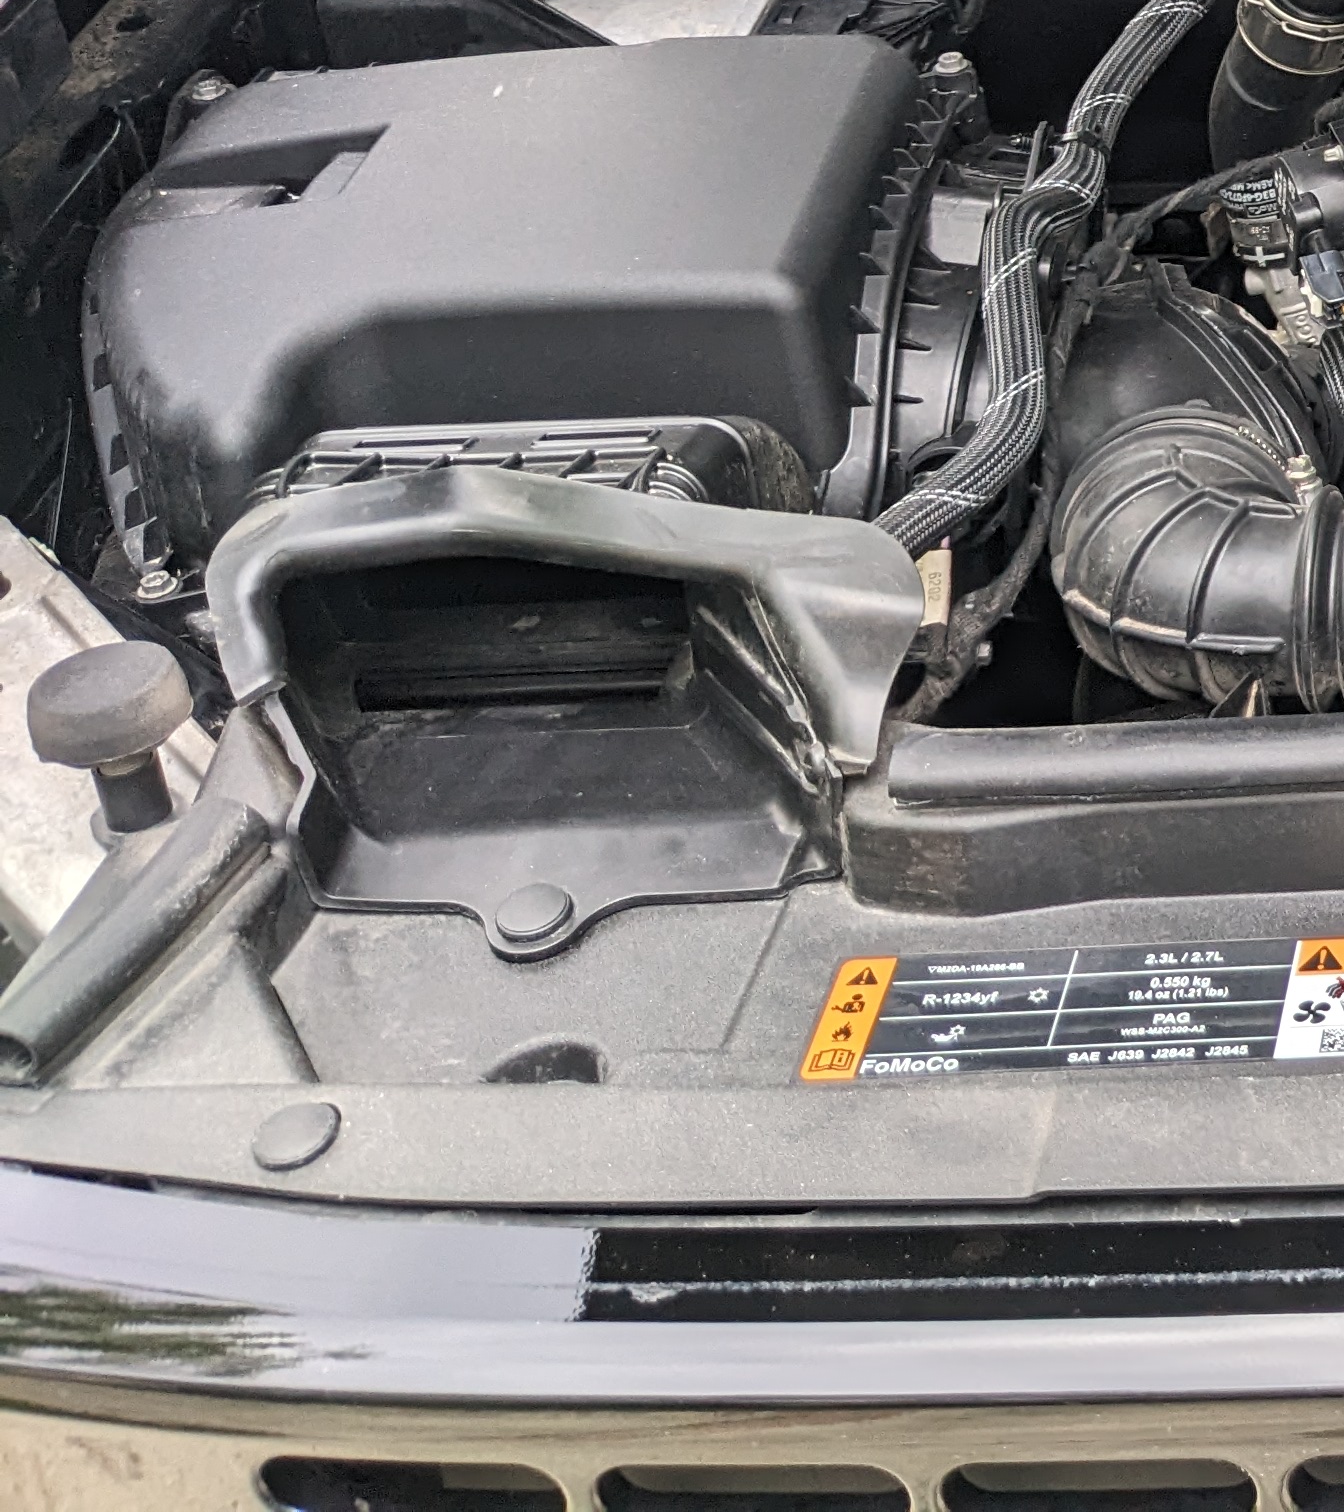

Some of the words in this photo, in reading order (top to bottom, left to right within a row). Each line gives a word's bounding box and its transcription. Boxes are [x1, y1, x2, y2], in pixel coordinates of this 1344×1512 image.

[927, 570, 942, 603] 6202
[1144, 952, 1178, 965] 2.3L
[1189, 950, 1225, 963] 2.7L
[1149, 975, 1190, 989] 0.550
[1191, 975, 1211, 989] kg
[922, 989, 1000, 1007] R-1234yf
[1127, 988, 1153, 1001] 19.4
[1154, 990, 1171, 1000] oz
[1172, 988, 1202, 1001] (1.21
[1205, 985, 1230, 998] lbs)
[1152, 1011, 1191, 1025] PAG
[1066, 1050, 1101, 1064] SAE
[1107, 1048, 1145, 1062] J639
[1150, 1046, 1196, 1060] J2842
[1204, 1044, 1249, 1058] J2845
[859, 1055, 960, 1075] FoMoCo
